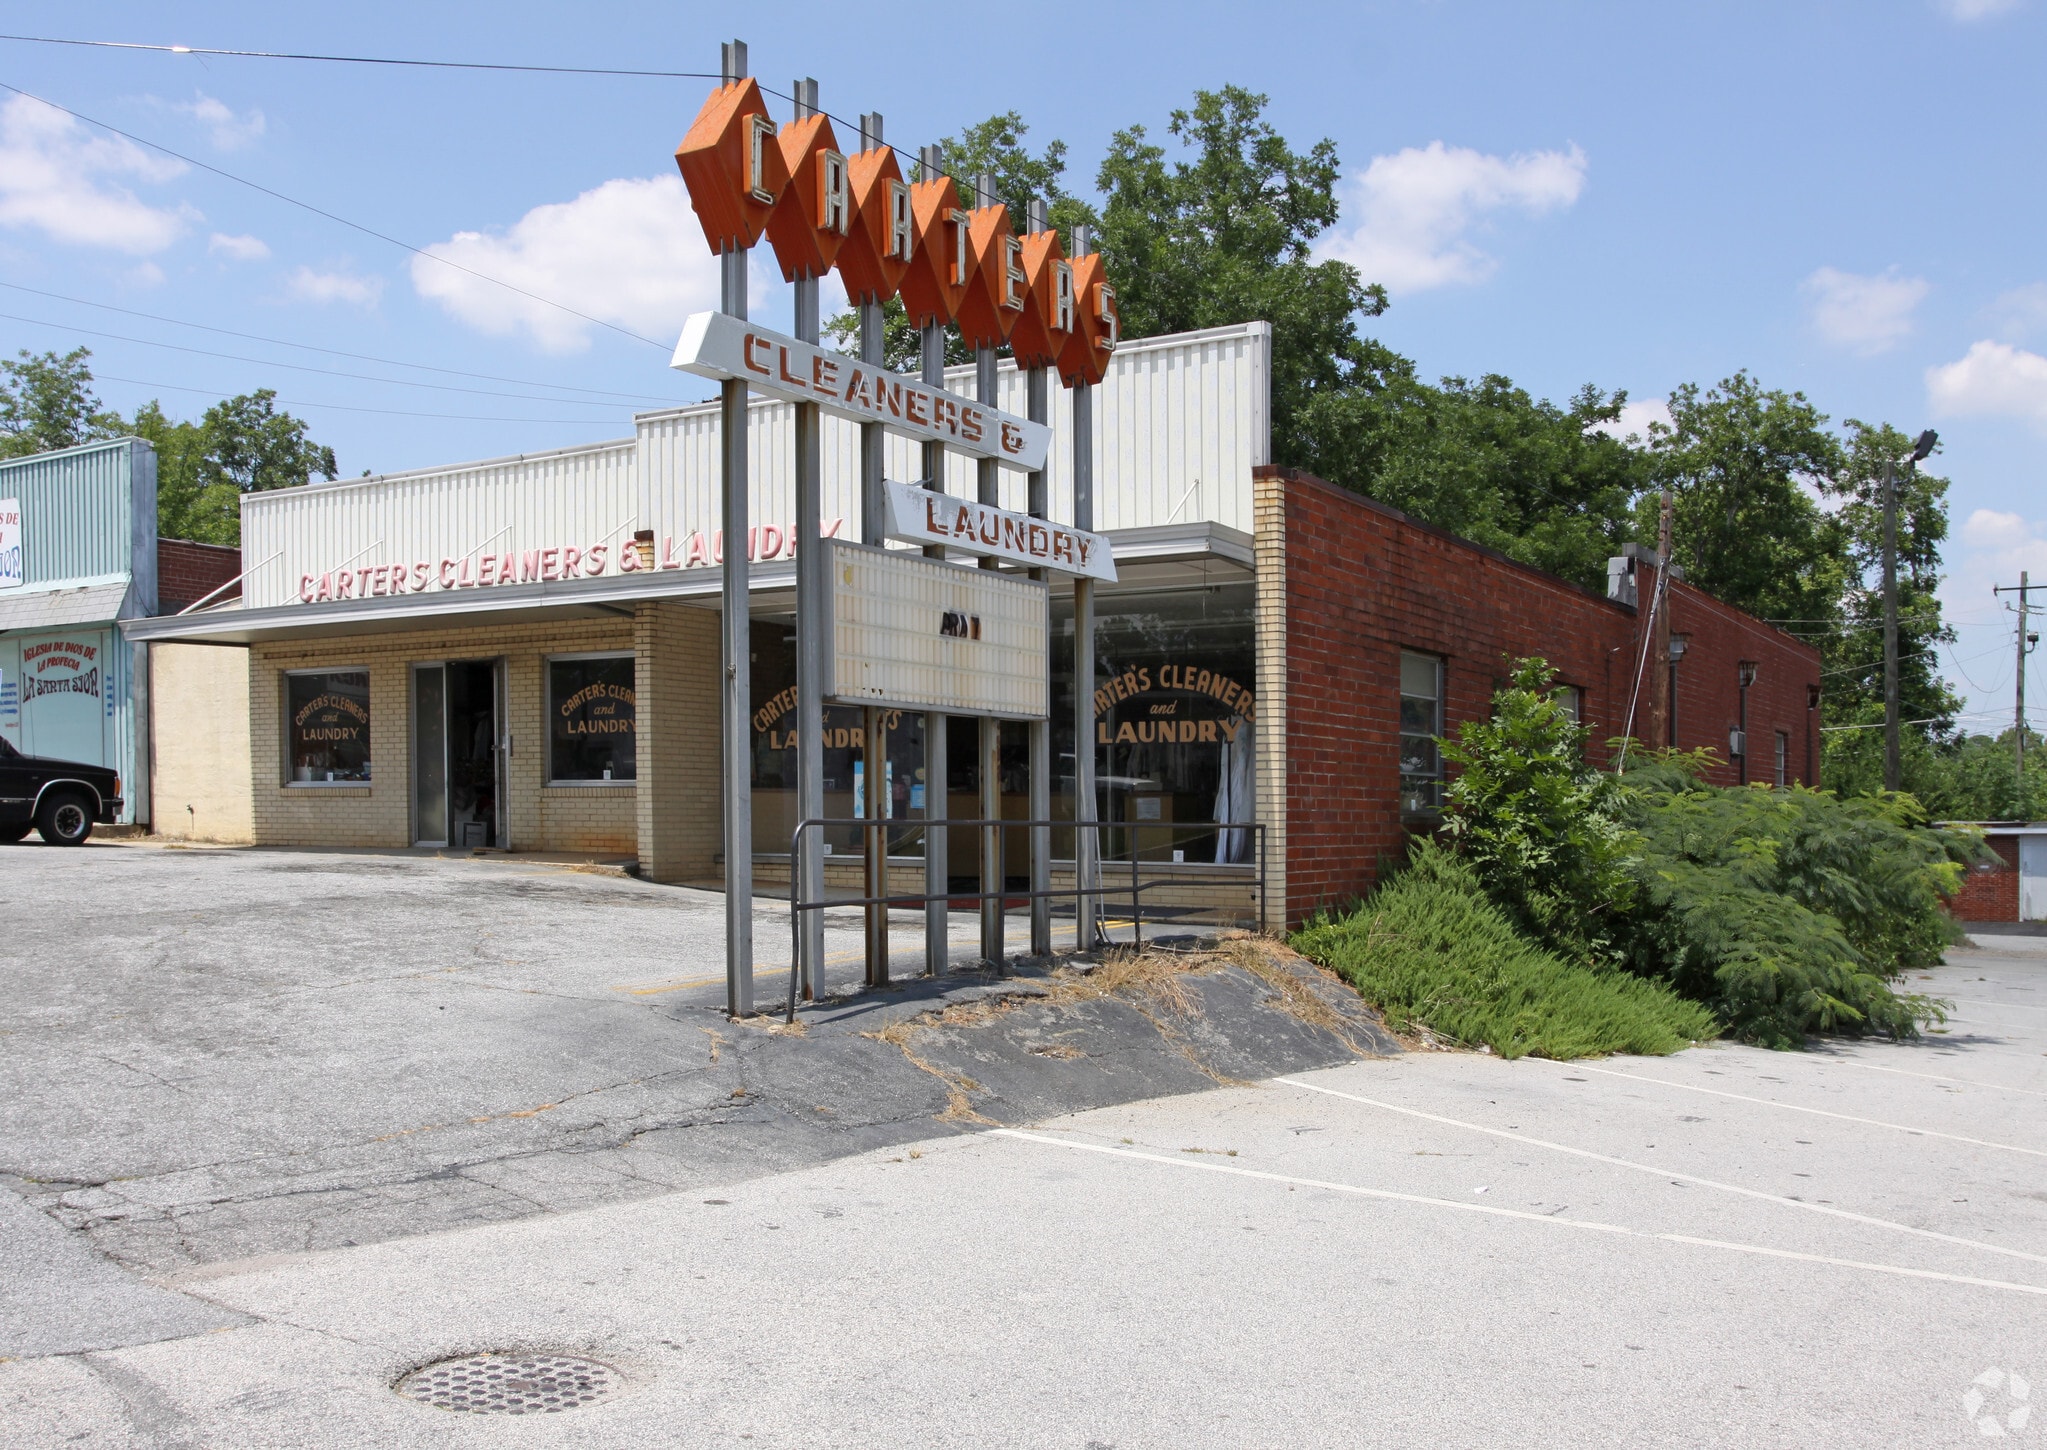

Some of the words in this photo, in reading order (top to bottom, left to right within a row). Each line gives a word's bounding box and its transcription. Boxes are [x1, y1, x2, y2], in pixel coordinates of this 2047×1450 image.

[742, 112, 1118, 352] CARTERS
[743, 333, 990, 442] CLEANERS
[1001, 420, 1027, 454] &
[925, 497, 1097, 568] LAUNDRY
[300, 561, 430, 603] CARTERS
[439, 544, 608, 589] CLEANERS
[619, 539, 644, 572] &
[23, 642, 53, 662] IGLESIA
[53, 641, 65, 652] DE
[65, 641, 84, 656] DIOS
[83, 646, 97, 661] DE
[37, 659, 46, 674] LA
[46, 656, 80, 671] PROFECIA
[608, 684, 636, 707] CLEAN
[1094, 663, 1151, 720] RTER'S
[321, 711, 339, 723] and
[330, 695, 368, 724] CLEANERS
[593, 701, 616, 715] and
[1149, 699, 1178, 715] and
[302, 727, 359, 741] LAUNDRY
[770, 728, 865, 750] LANDR
[1098, 719, 1243, 744] LAUNDRY
